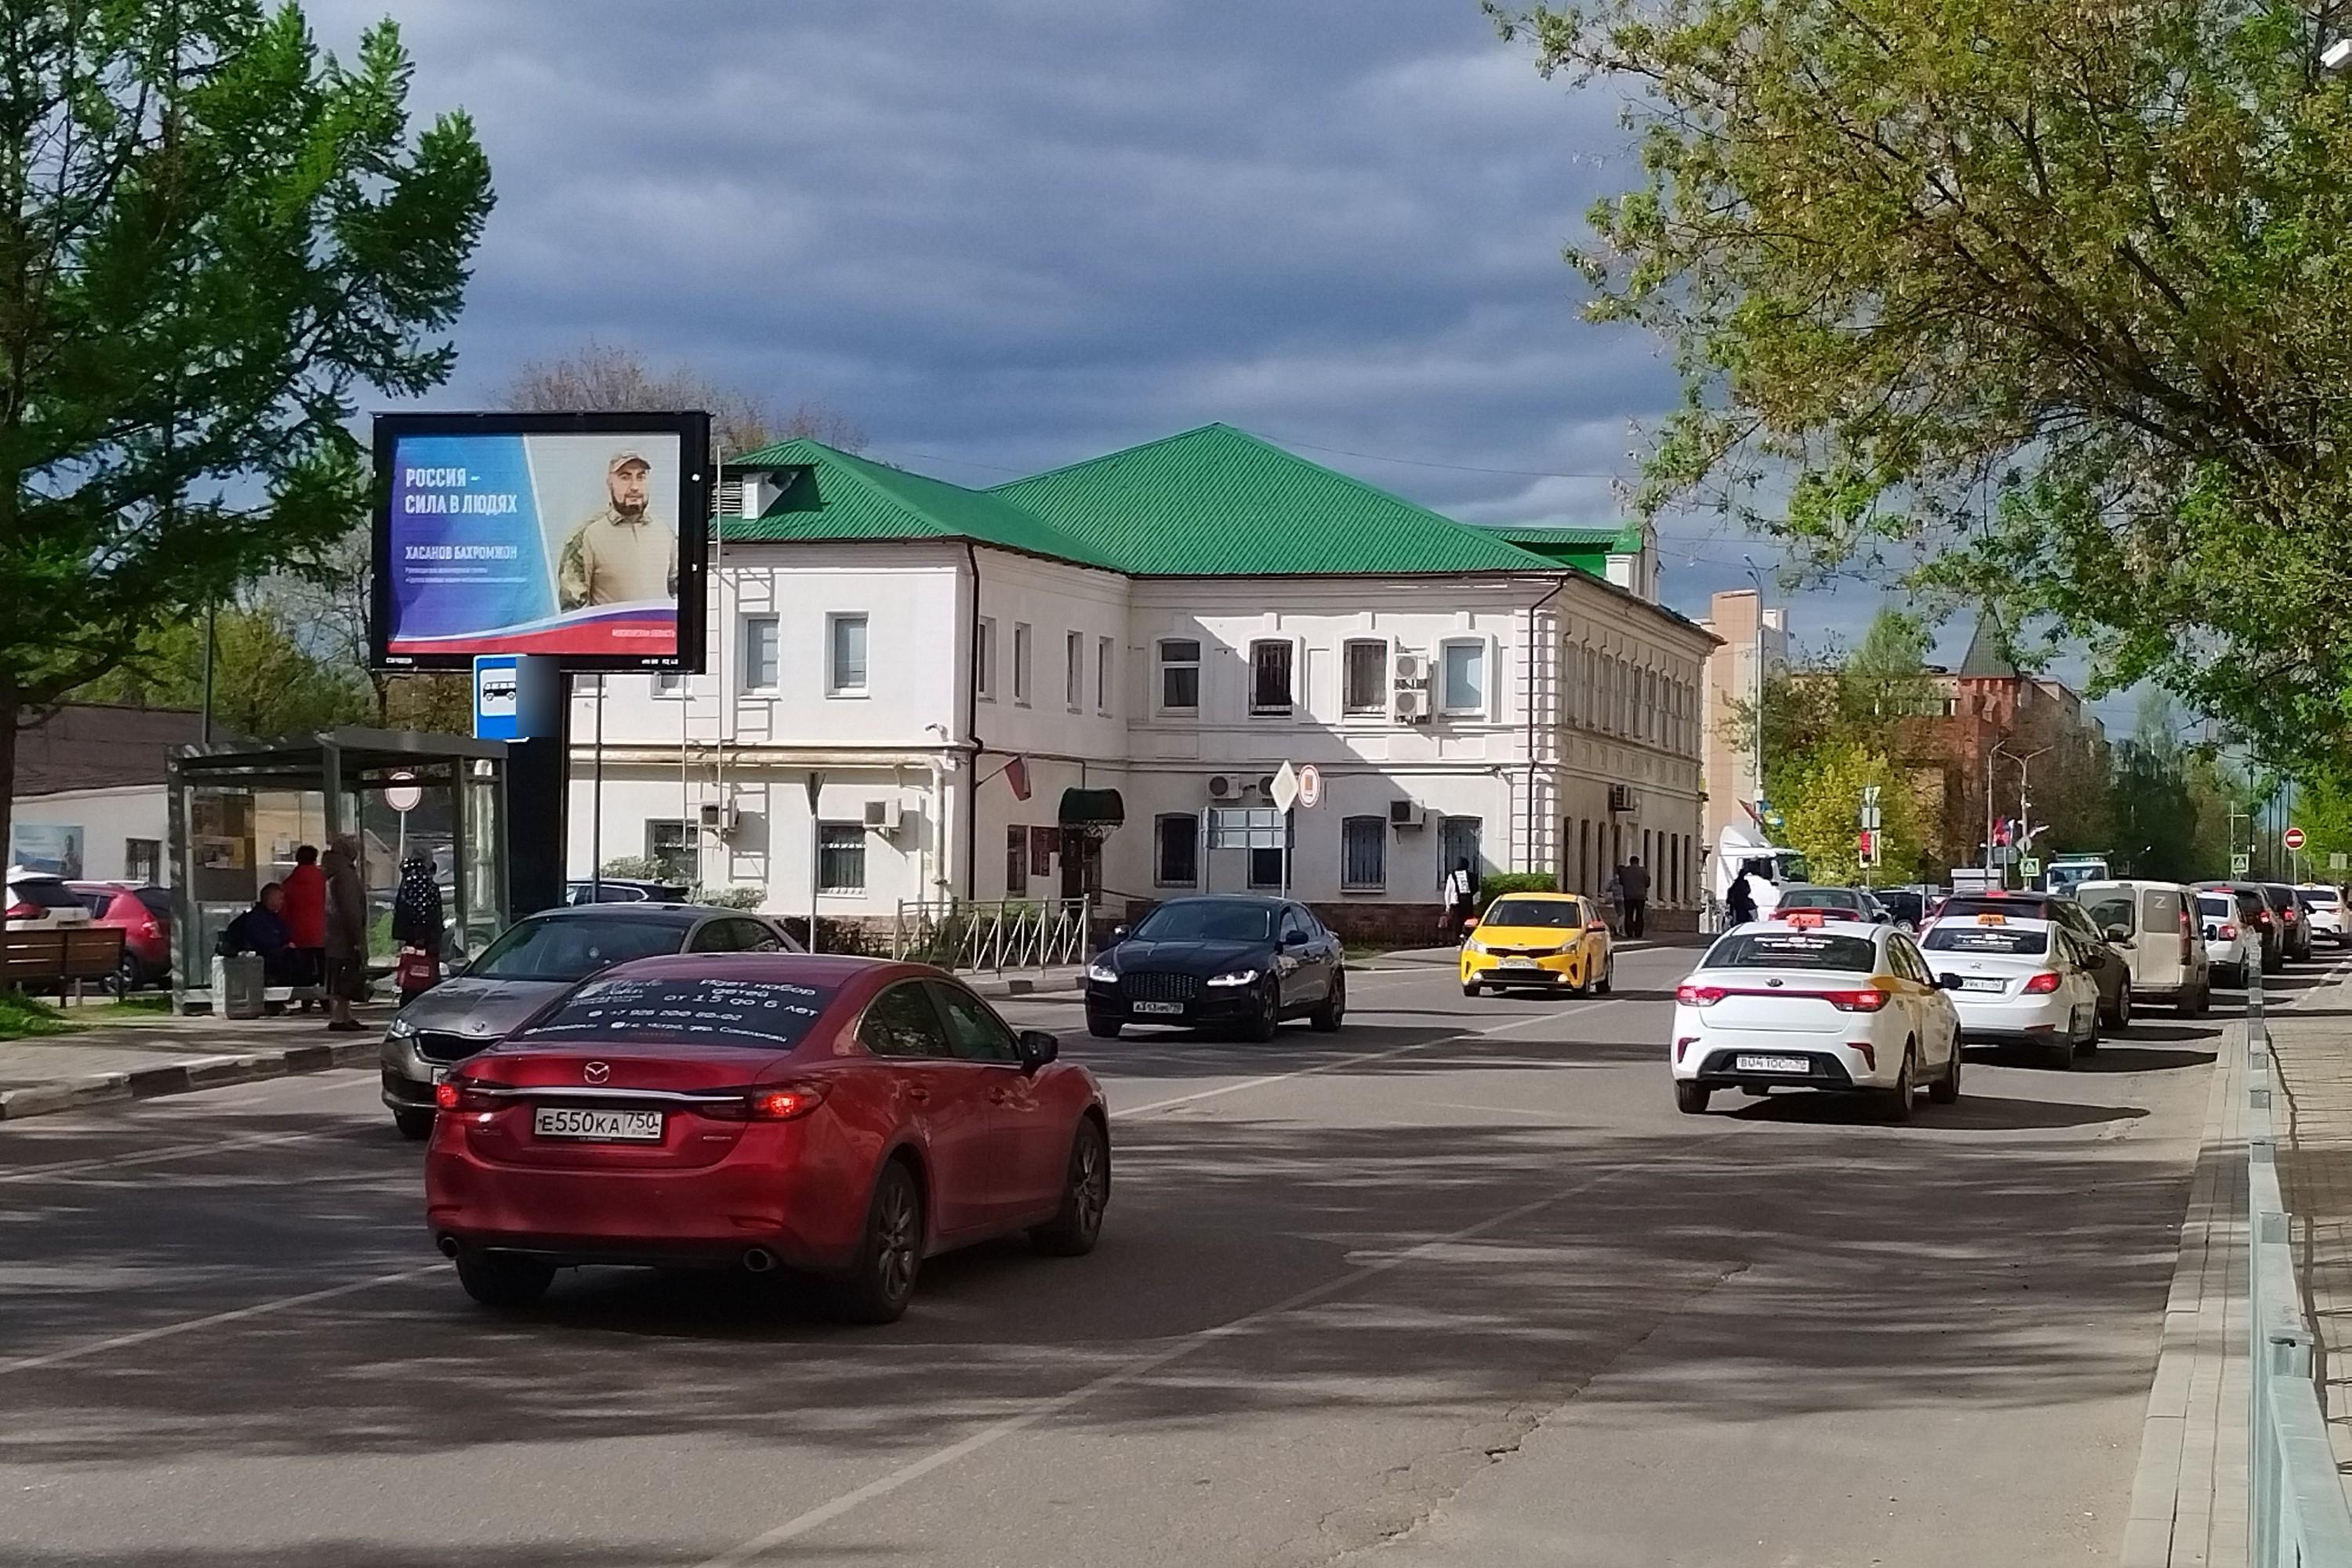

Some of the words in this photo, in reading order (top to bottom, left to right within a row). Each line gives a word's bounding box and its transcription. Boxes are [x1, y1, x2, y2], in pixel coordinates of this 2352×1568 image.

[405, 468, 466, 487] РОССИЯ
[405, 495, 448, 514] СИЛА
[449, 495, 460, 514] В
[462, 495, 517, 515] ЛЮДЯХ
[405, 546, 452, 560] ХАСАНОВ
[753, 983, 816, 996] набор
[763, 1000, 779, 1008] 6
[784, 1004, 819, 1017] лет
